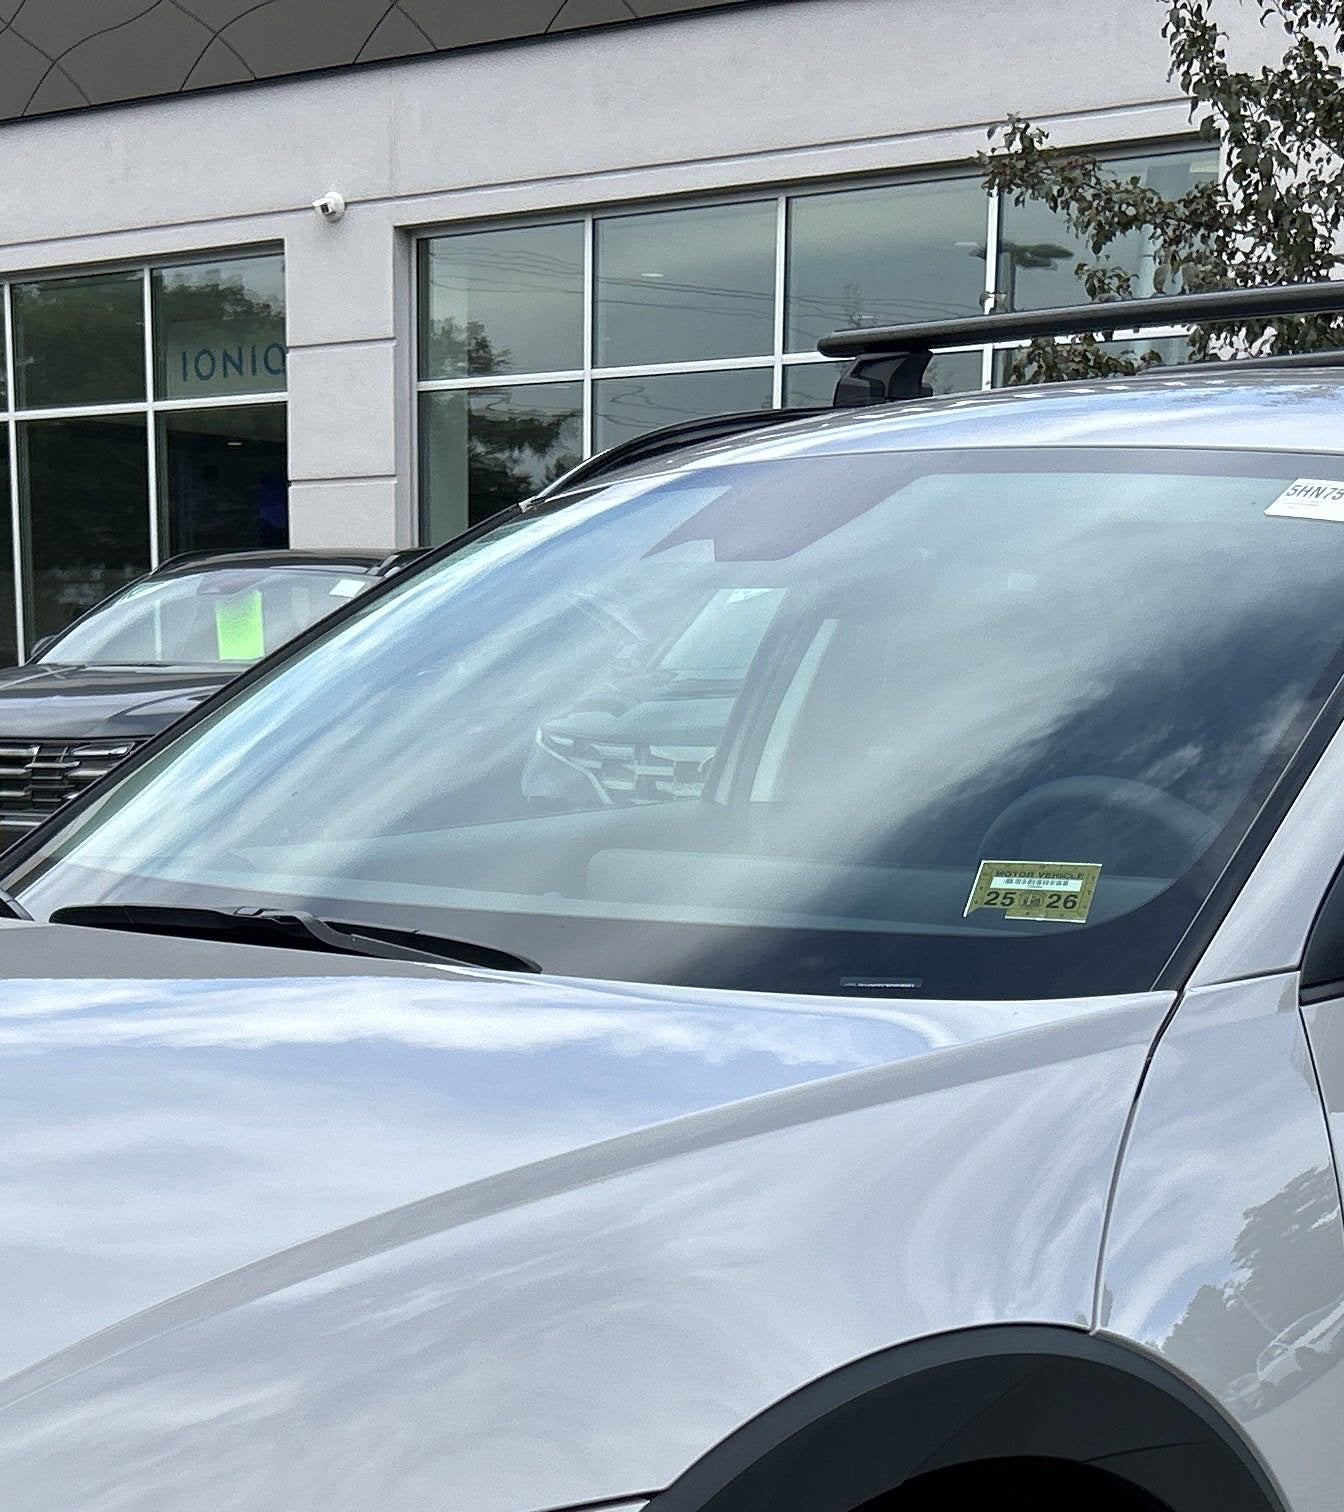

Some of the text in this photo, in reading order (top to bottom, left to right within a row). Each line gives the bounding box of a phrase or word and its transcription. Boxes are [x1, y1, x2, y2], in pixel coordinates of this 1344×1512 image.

[996, 870, 1034, 878] MOTOR
[984, 891, 1078, 910] 25 26
